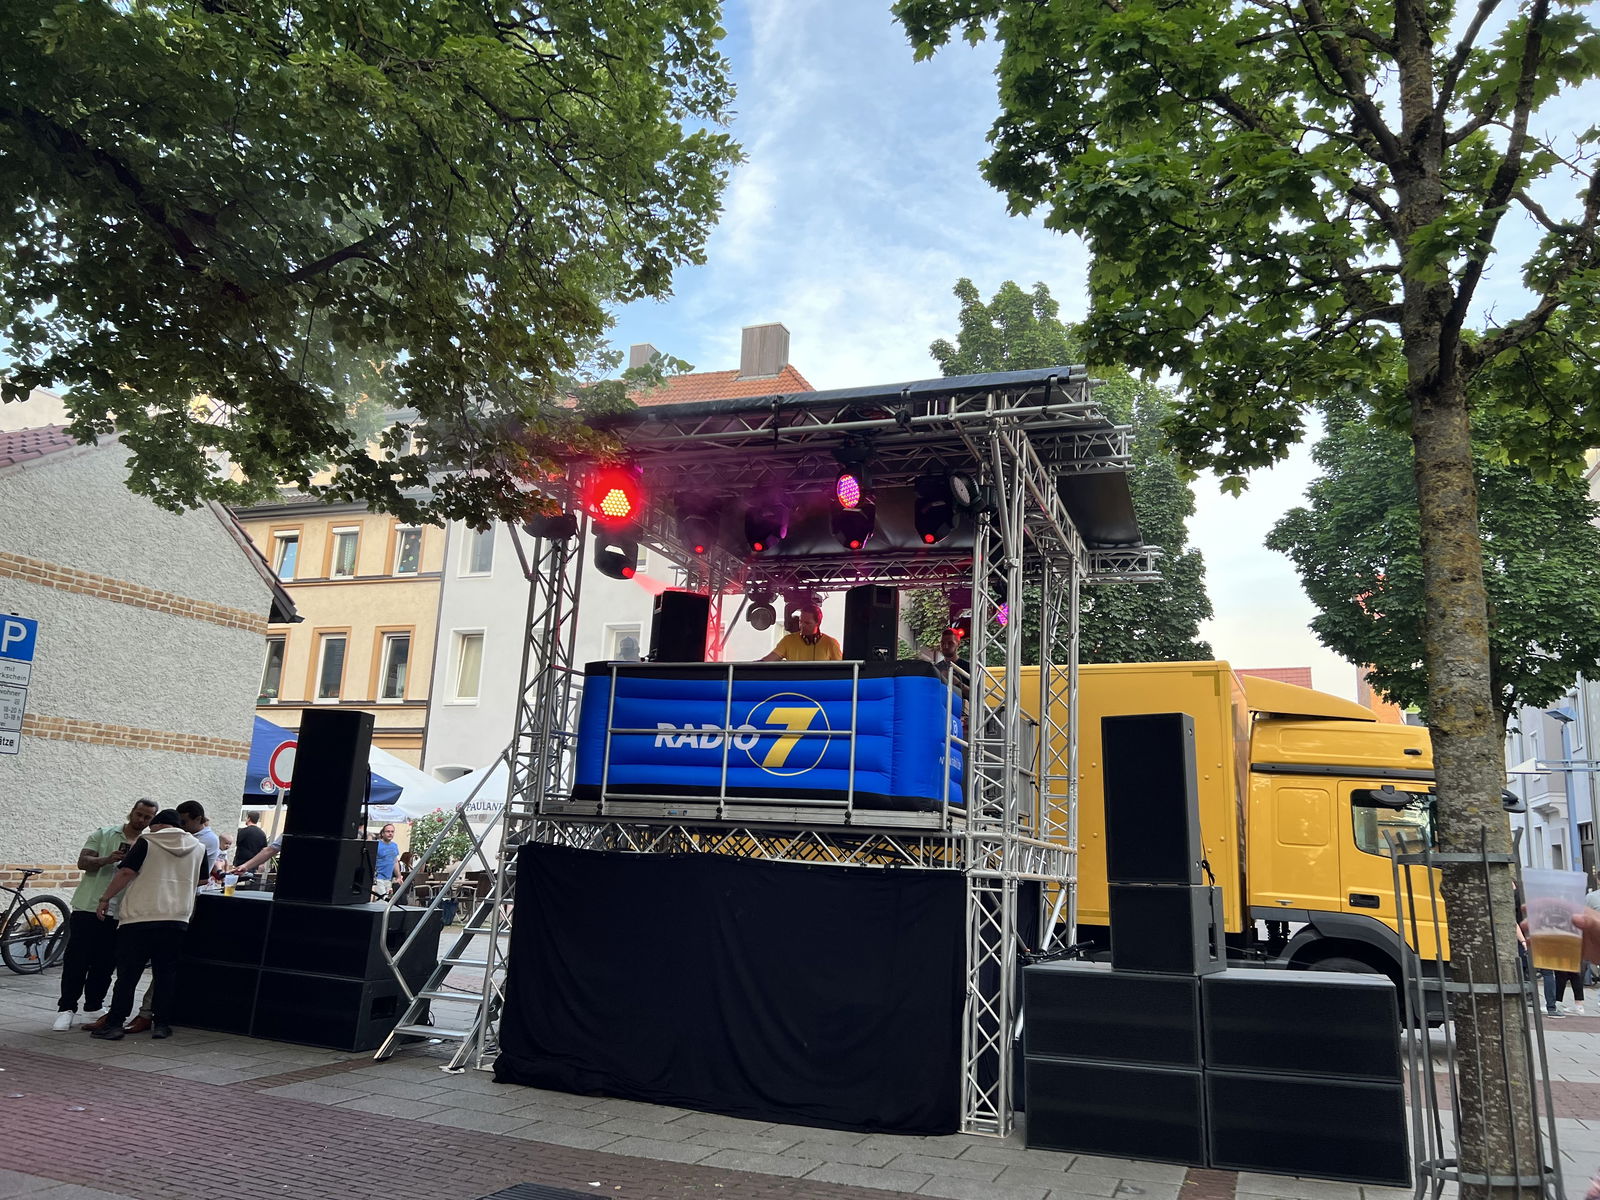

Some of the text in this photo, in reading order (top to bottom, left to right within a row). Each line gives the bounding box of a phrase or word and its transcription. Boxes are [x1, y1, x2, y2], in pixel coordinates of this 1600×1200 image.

[1, 620, 27, 652] P
[654, 707, 820, 768] RADIO 7
